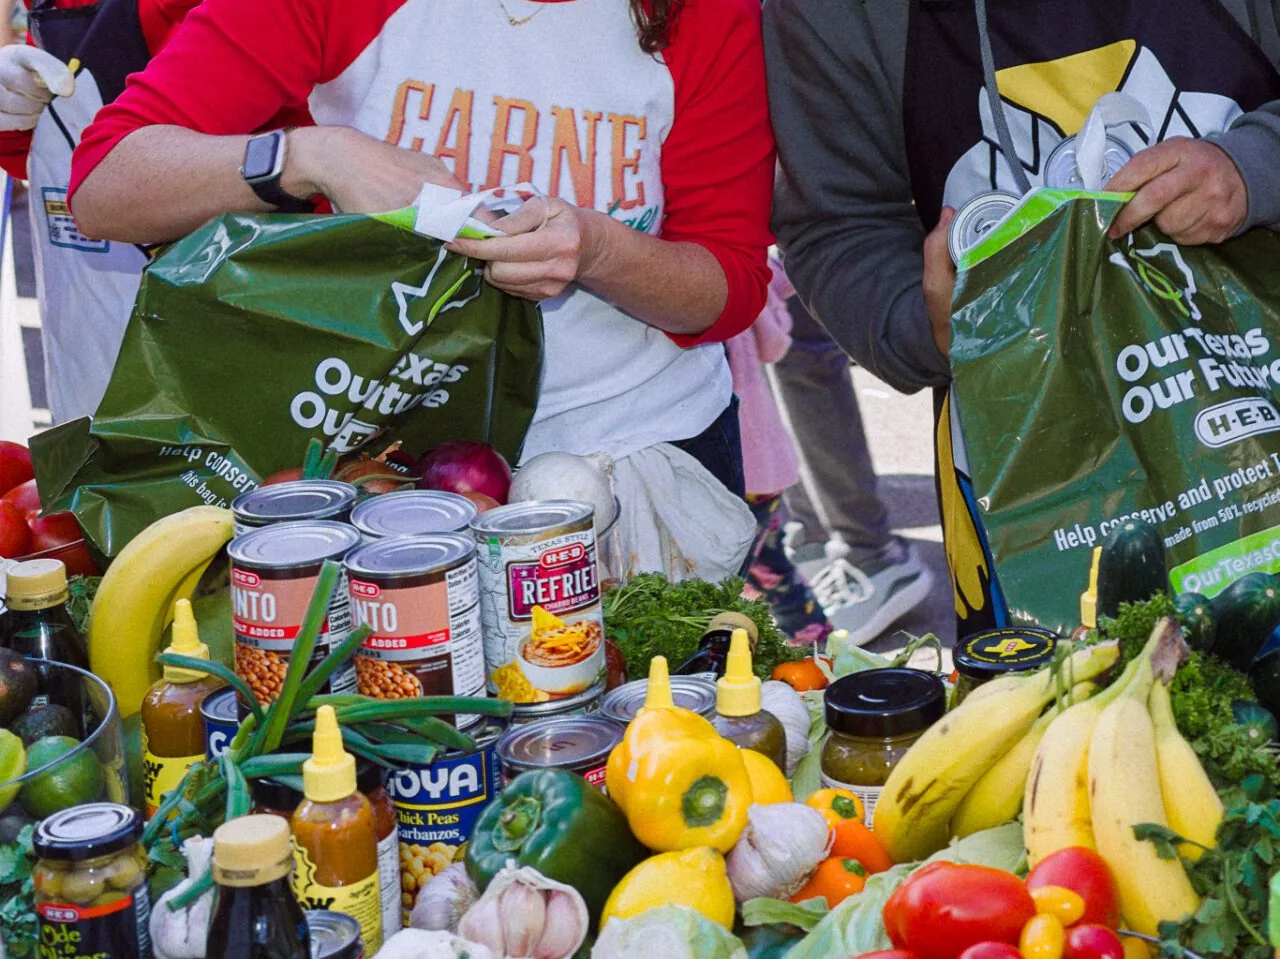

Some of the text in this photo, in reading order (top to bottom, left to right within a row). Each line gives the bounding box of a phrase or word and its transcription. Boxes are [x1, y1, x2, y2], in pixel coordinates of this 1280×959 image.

[384, 78, 648, 210] CARNE
[1116, 327, 1270, 382] Our Texas
[1122, 369, 1195, 424] Our
[159, 446, 202, 463] Help
[196, 481, 218, 505] bag
[1054, 523, 1097, 551] Help
[1177, 478, 1212, 510] and
[1213, 458, 1271, 500] protect
[1163, 526, 1193, 548] made
[1192, 514, 1219, 534] from
[1217, 503, 1243, 523] 50%
[530, 538, 562, 553] TEXAS
[250, 626, 285, 638] ADDED
[427, 813, 460, 826] Peas
